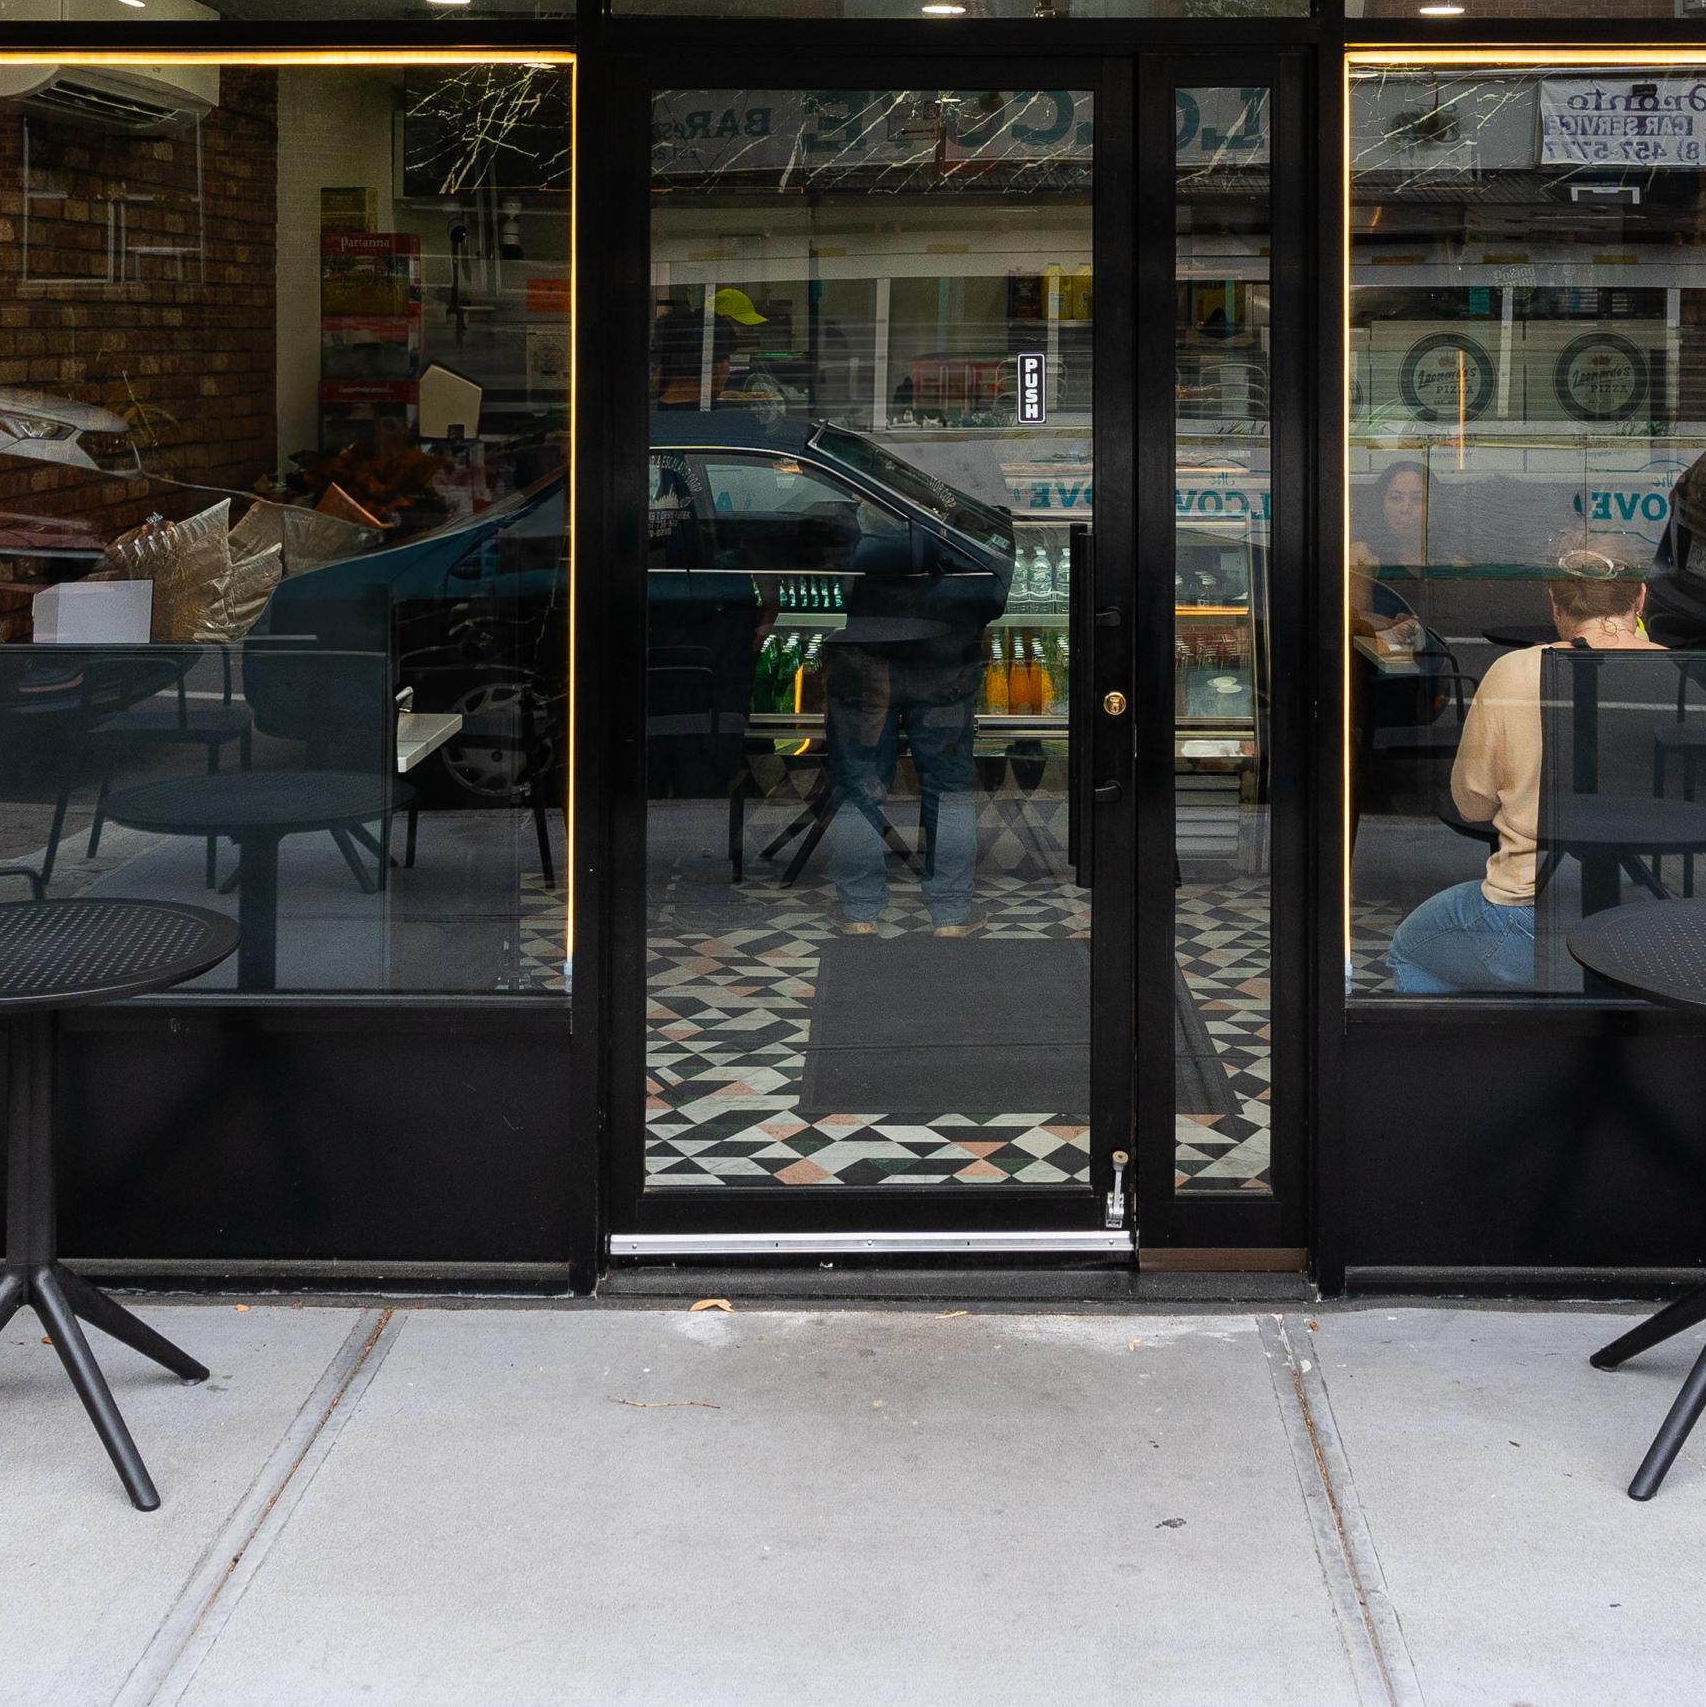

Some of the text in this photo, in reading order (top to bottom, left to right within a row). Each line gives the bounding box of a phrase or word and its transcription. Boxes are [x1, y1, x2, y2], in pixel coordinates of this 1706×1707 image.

[340, 235, 390, 253] Partanna
[1024, 358, 1039, 419] PUSH
[1435, 385, 1475, 394] PIZA
